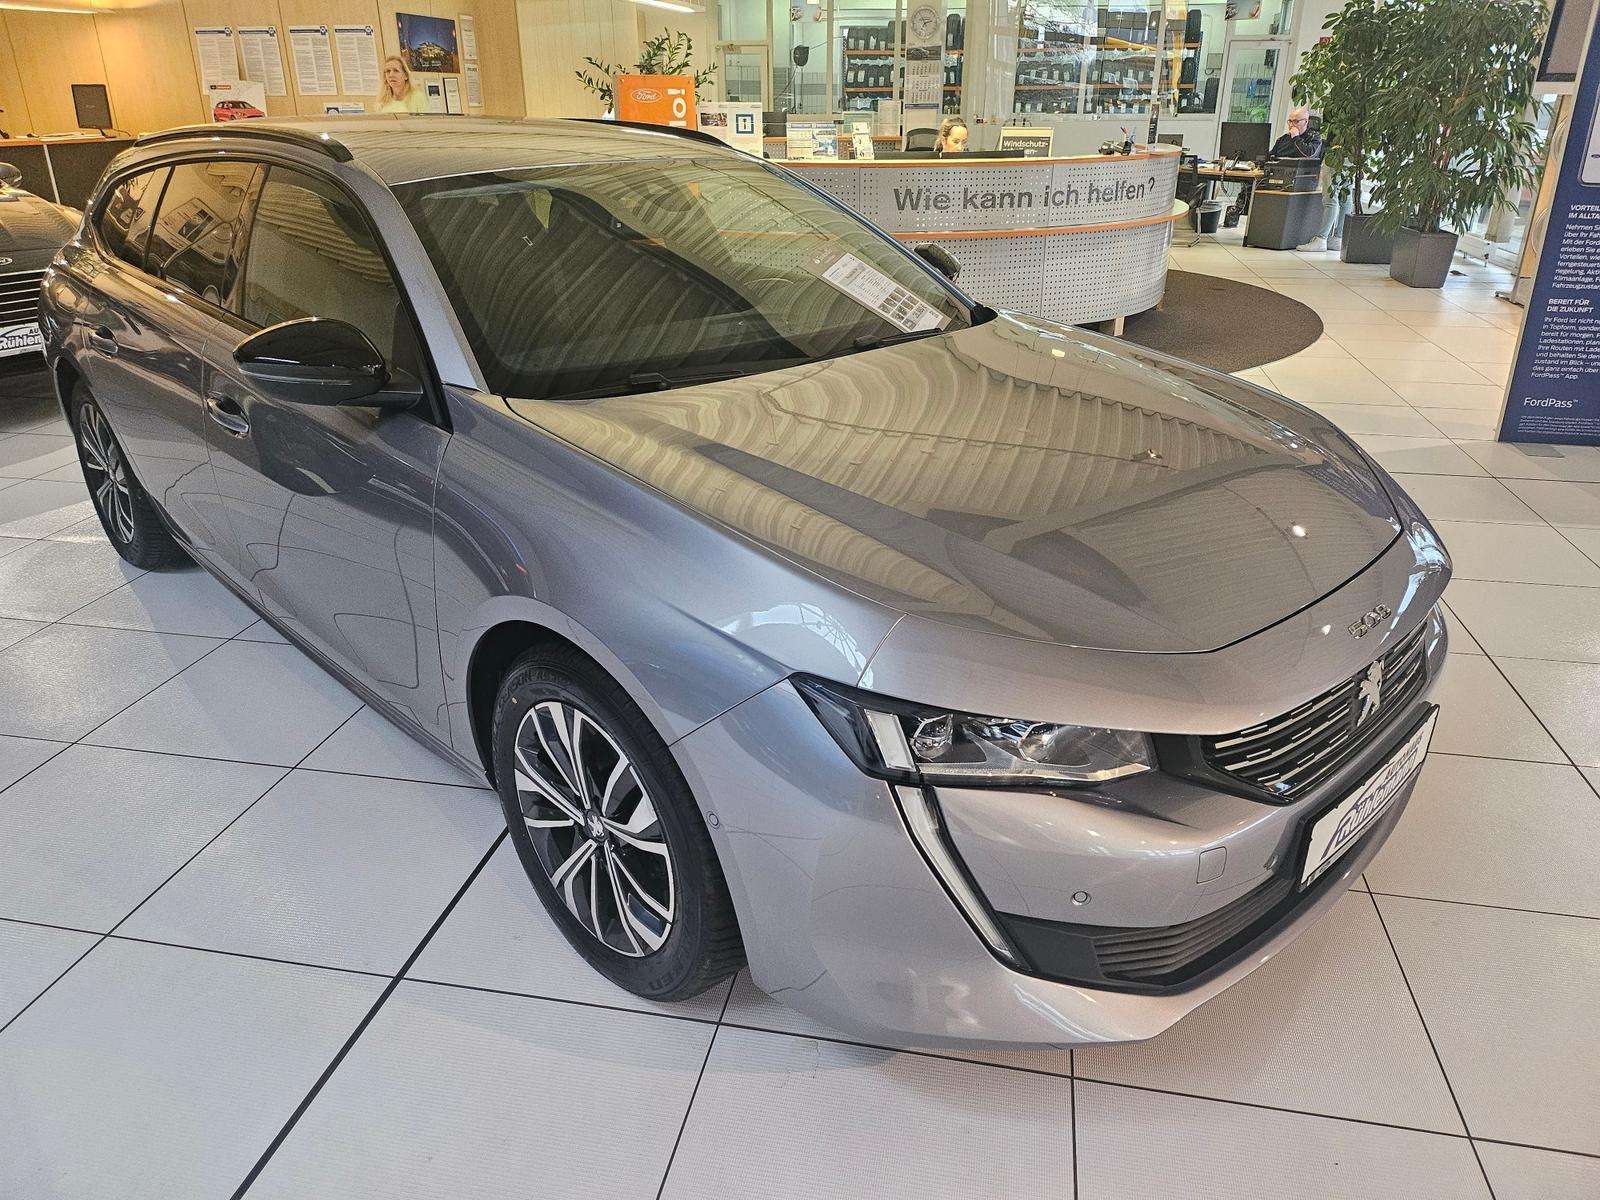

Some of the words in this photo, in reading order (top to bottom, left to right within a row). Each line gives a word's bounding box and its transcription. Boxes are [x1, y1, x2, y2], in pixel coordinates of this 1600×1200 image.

[1003, 140, 1049, 148] Windschutz-
[893, 188, 950, 211] Wie
[962, 187, 1033, 211] kann
[1043, 185, 1079, 207] ich
[1574, 298, 1590, 306] FÜR
[1348, 603, 1391, 639] 508
